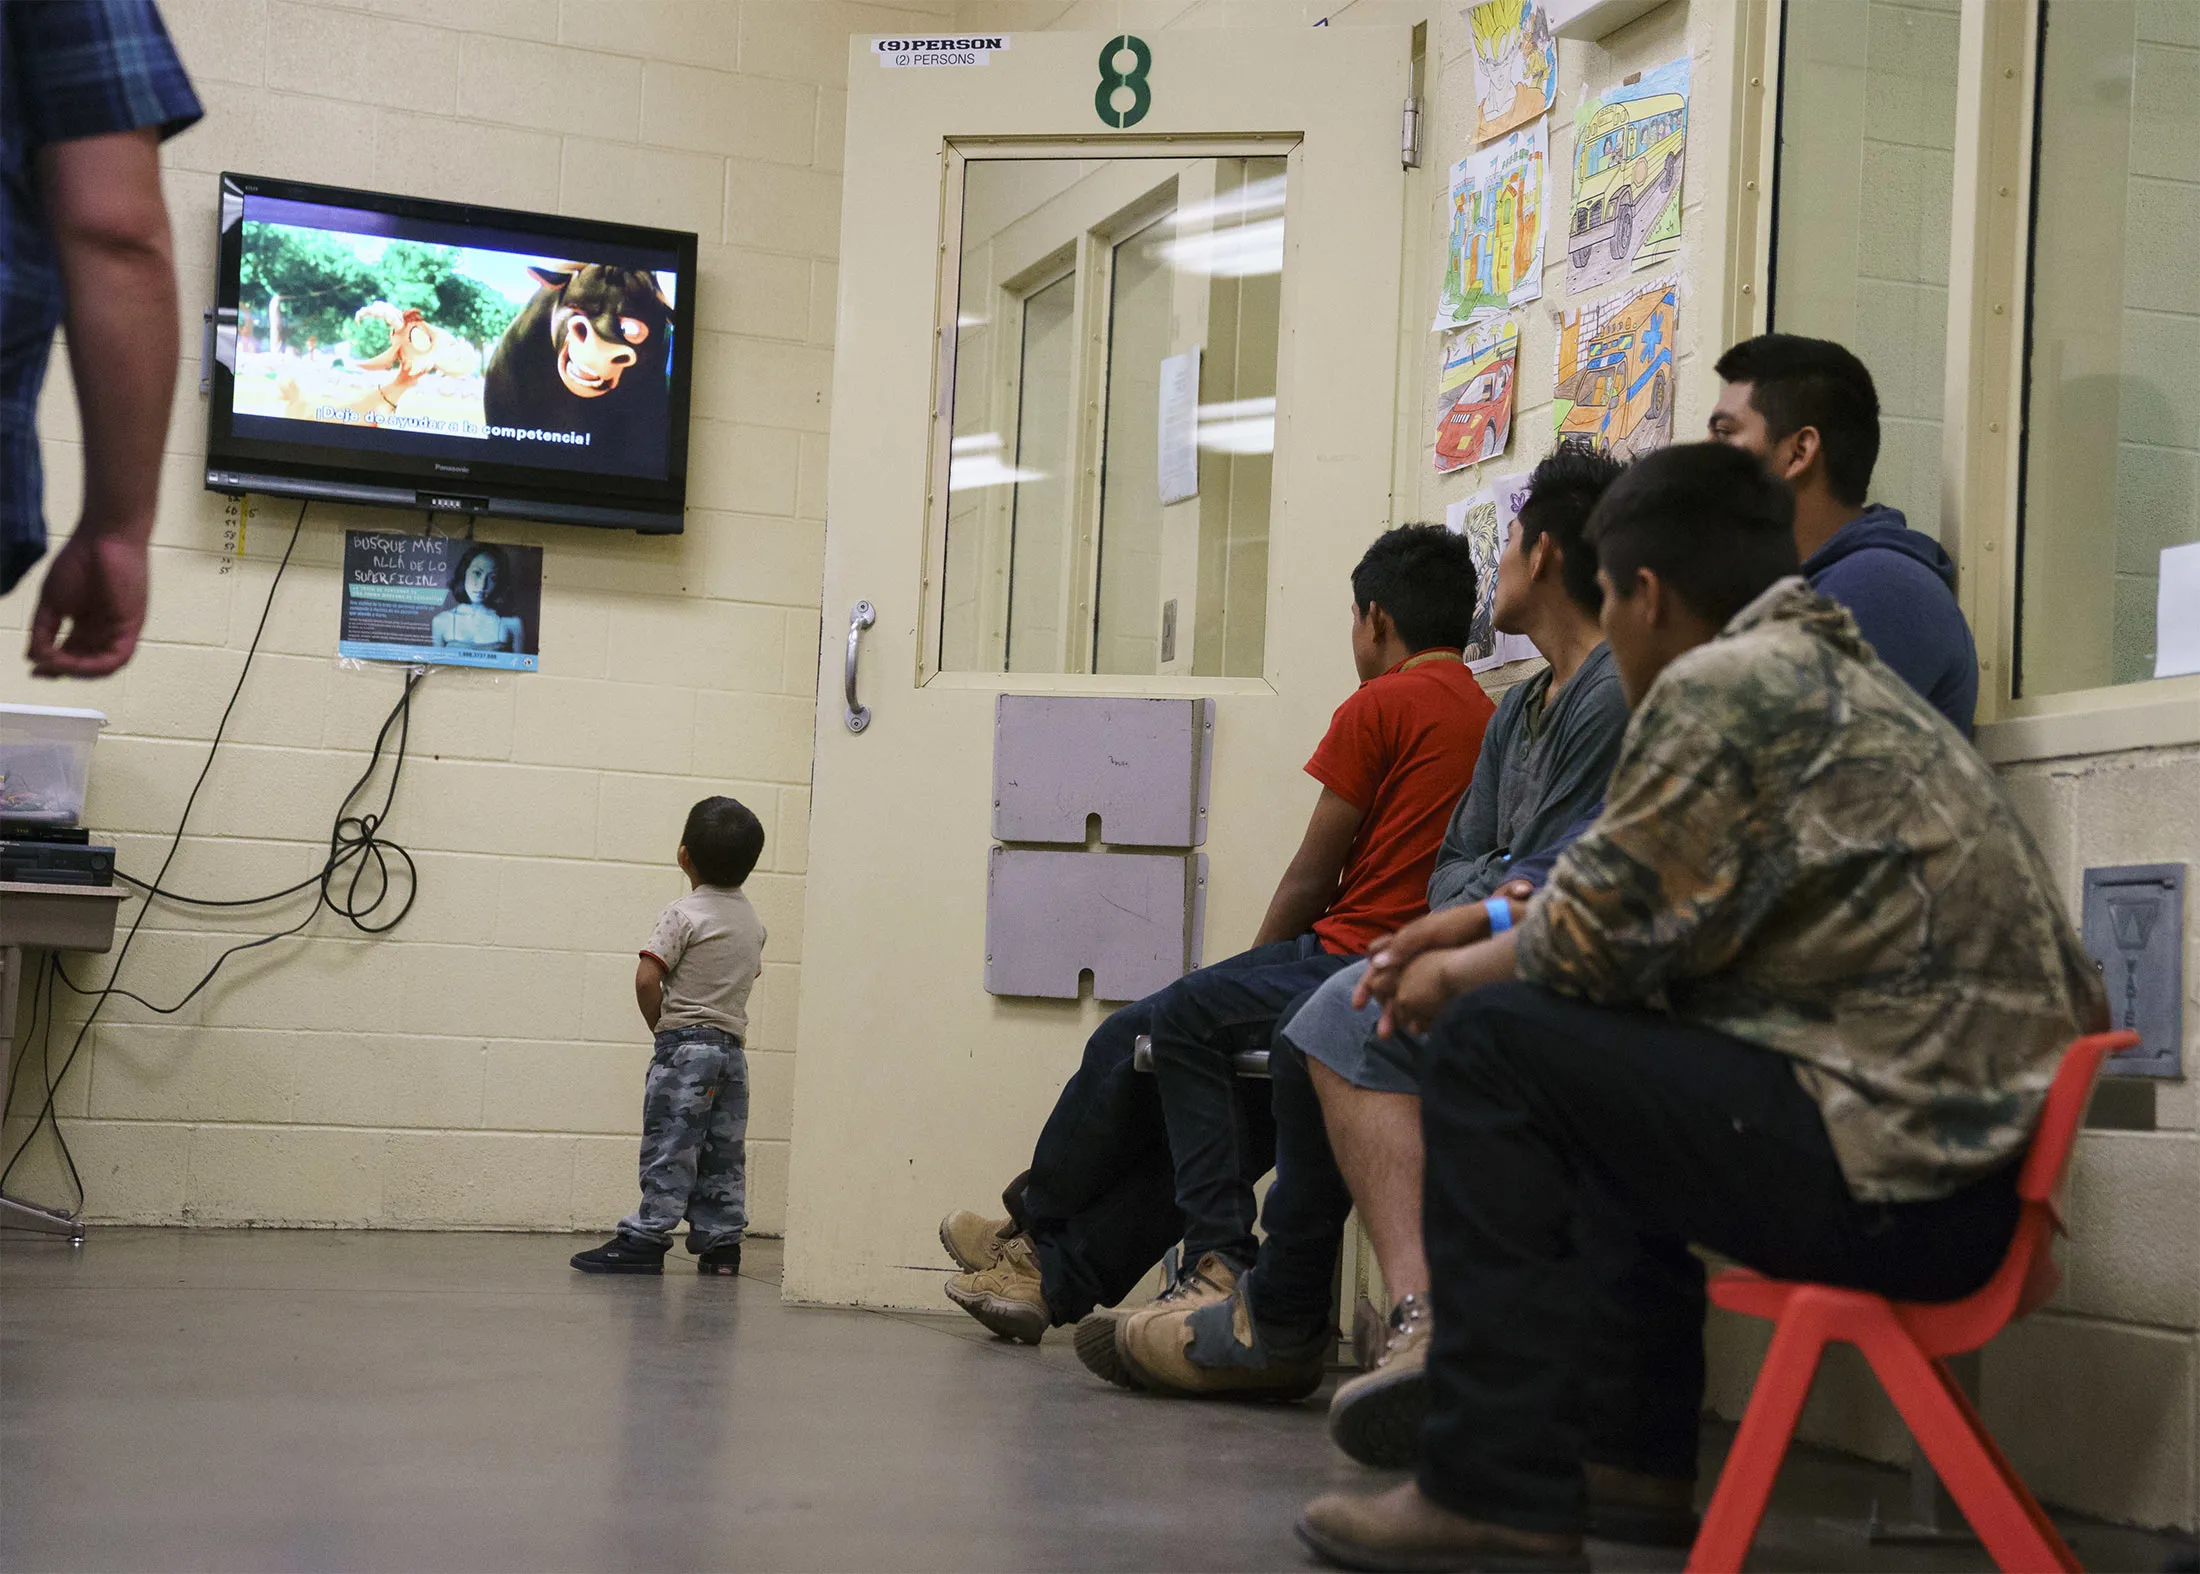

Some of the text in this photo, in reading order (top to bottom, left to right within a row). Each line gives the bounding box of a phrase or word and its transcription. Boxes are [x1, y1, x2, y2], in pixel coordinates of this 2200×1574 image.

[878, 38, 1002, 51] (9)PERSON
[895, 53, 975, 66] (2) PERSONS
[1095, 34, 1152, 129] 8
[364, 408, 386, 424] de
[387, 414, 446, 429] ayudar
[448, 421, 460, 433] a
[462, 420, 478, 434] la
[482, 424, 591, 446] competencia!
[353, 534, 442, 554] BUSQUE MÁS
[373, 554, 447, 572] ALLÁ DE LO
[354, 569, 438, 586] SUPERFICIAL
